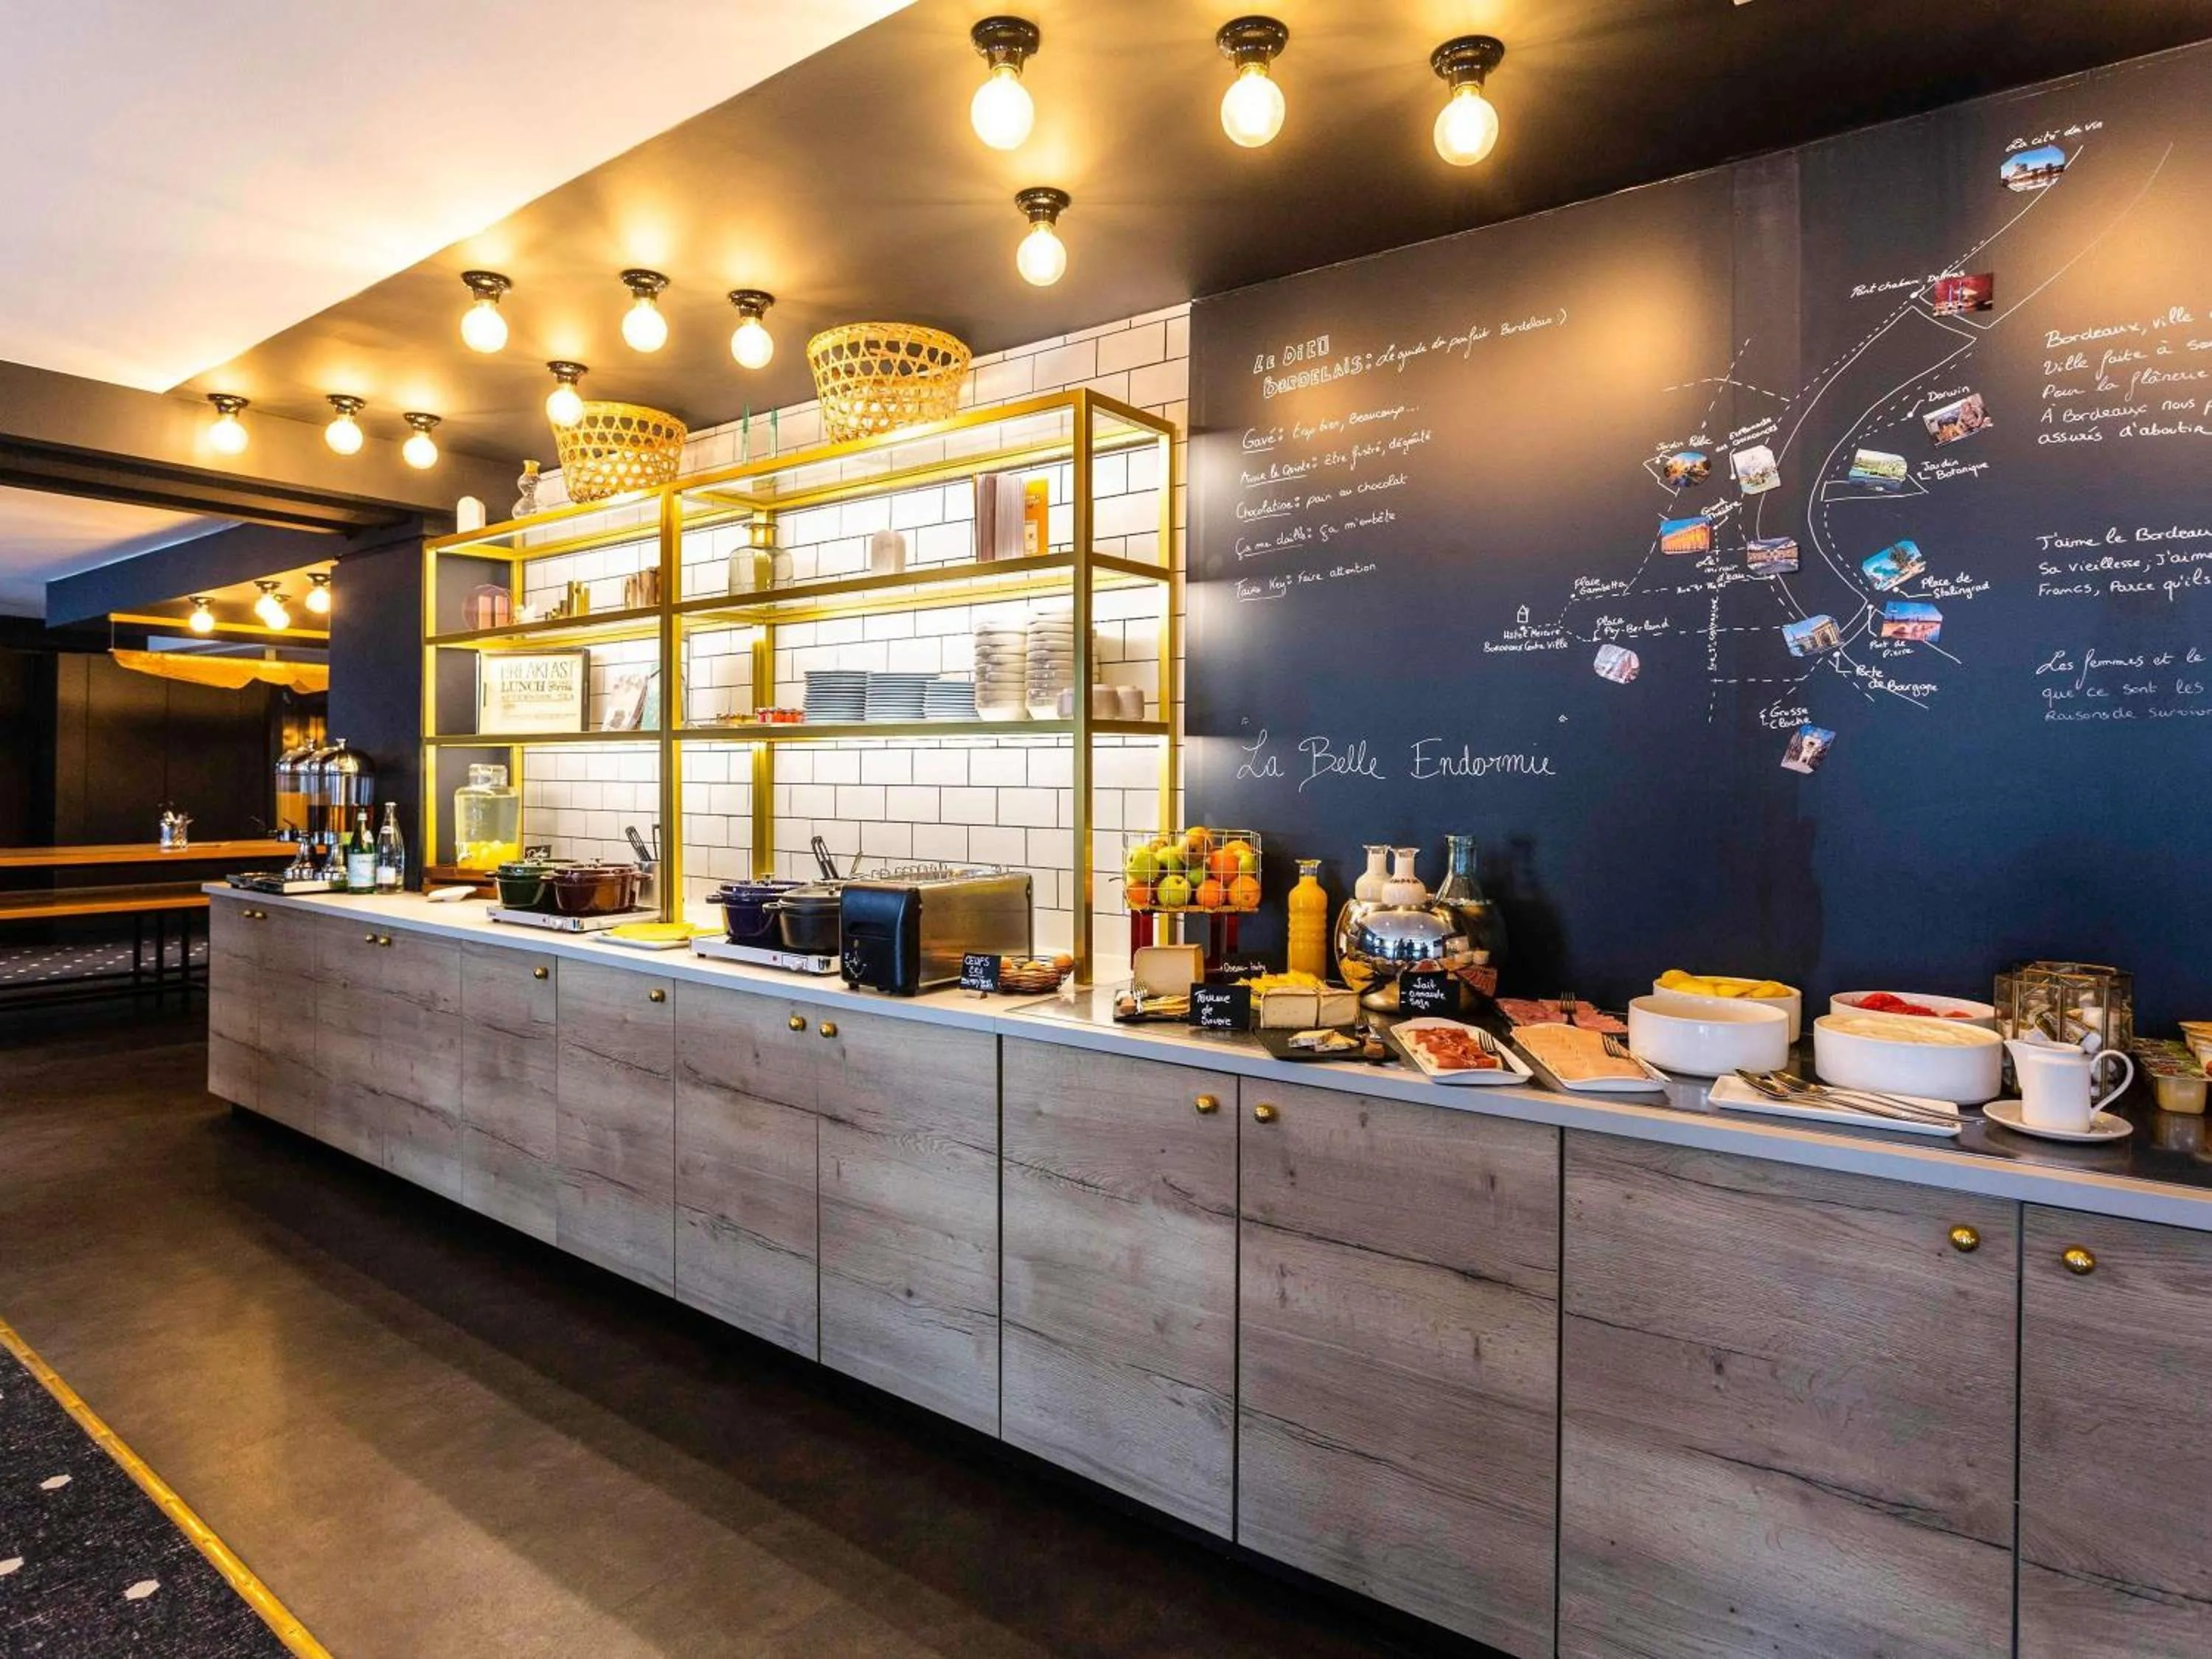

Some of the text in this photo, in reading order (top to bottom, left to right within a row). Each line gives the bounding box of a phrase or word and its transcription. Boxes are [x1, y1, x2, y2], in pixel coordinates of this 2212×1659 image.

[2045, 307, 2195, 349] Bordeaux, ville
[1398, 342, 1427, 372] guide
[1446, 326, 1491, 359] parfait
[2096, 349, 2147, 380] faite
[2157, 340, 2173, 355] à
[1927, 386, 1970, 402] Darwin
[2097, 376, 2119, 392] la
[2125, 367, 2209, 402] flânerie
[2063, 405, 2147, 424] Bordeaux
[2162, 398, 2195, 410] nous
[2038, 426, 2103, 445] assurés
[1307, 494, 1332, 510] pain
[2036, 532, 2102, 550] J'aime
[2106, 526, 2127, 543] le
[1329, 563, 1377, 577] attention
[1956, 571, 1973, 583] de
[1933, 580, 1991, 599] Stalingrad
[2163, 568, 2212, 602] qu'ils
[2036, 647, 2206, 690] Les femmes et le
[501, 681, 546, 692] LUNCH
[2042, 678, 2204, 709] que ce sont les
[1237, 729, 1557, 793] La Belle Endormie
